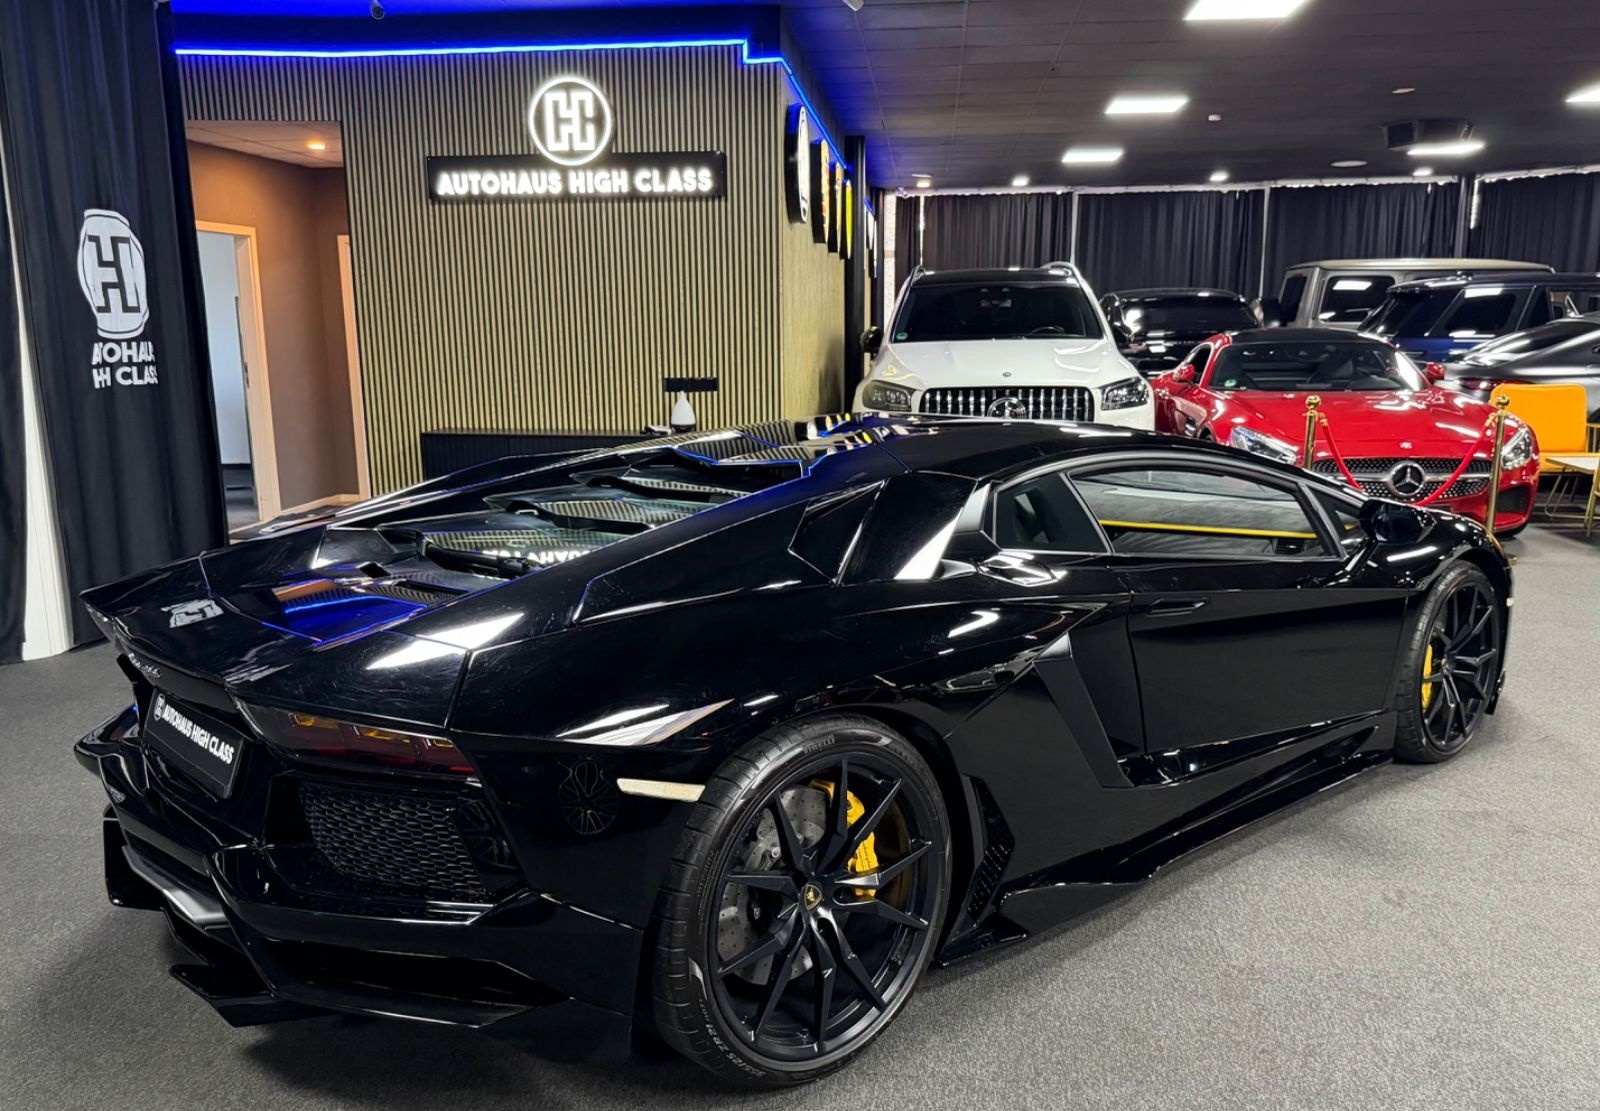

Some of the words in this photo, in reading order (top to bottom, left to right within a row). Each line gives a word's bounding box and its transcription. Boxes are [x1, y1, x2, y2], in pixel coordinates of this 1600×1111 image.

[437, 170, 562, 196] AUTOHAUS
[567, 170, 629, 194] HIGH
[634, 168, 713, 193] CLASS
[161, 703, 193, 738] AUTOHAUS
[190, 723, 211, 750] HIGH
[208, 736, 235, 765] CLASS
